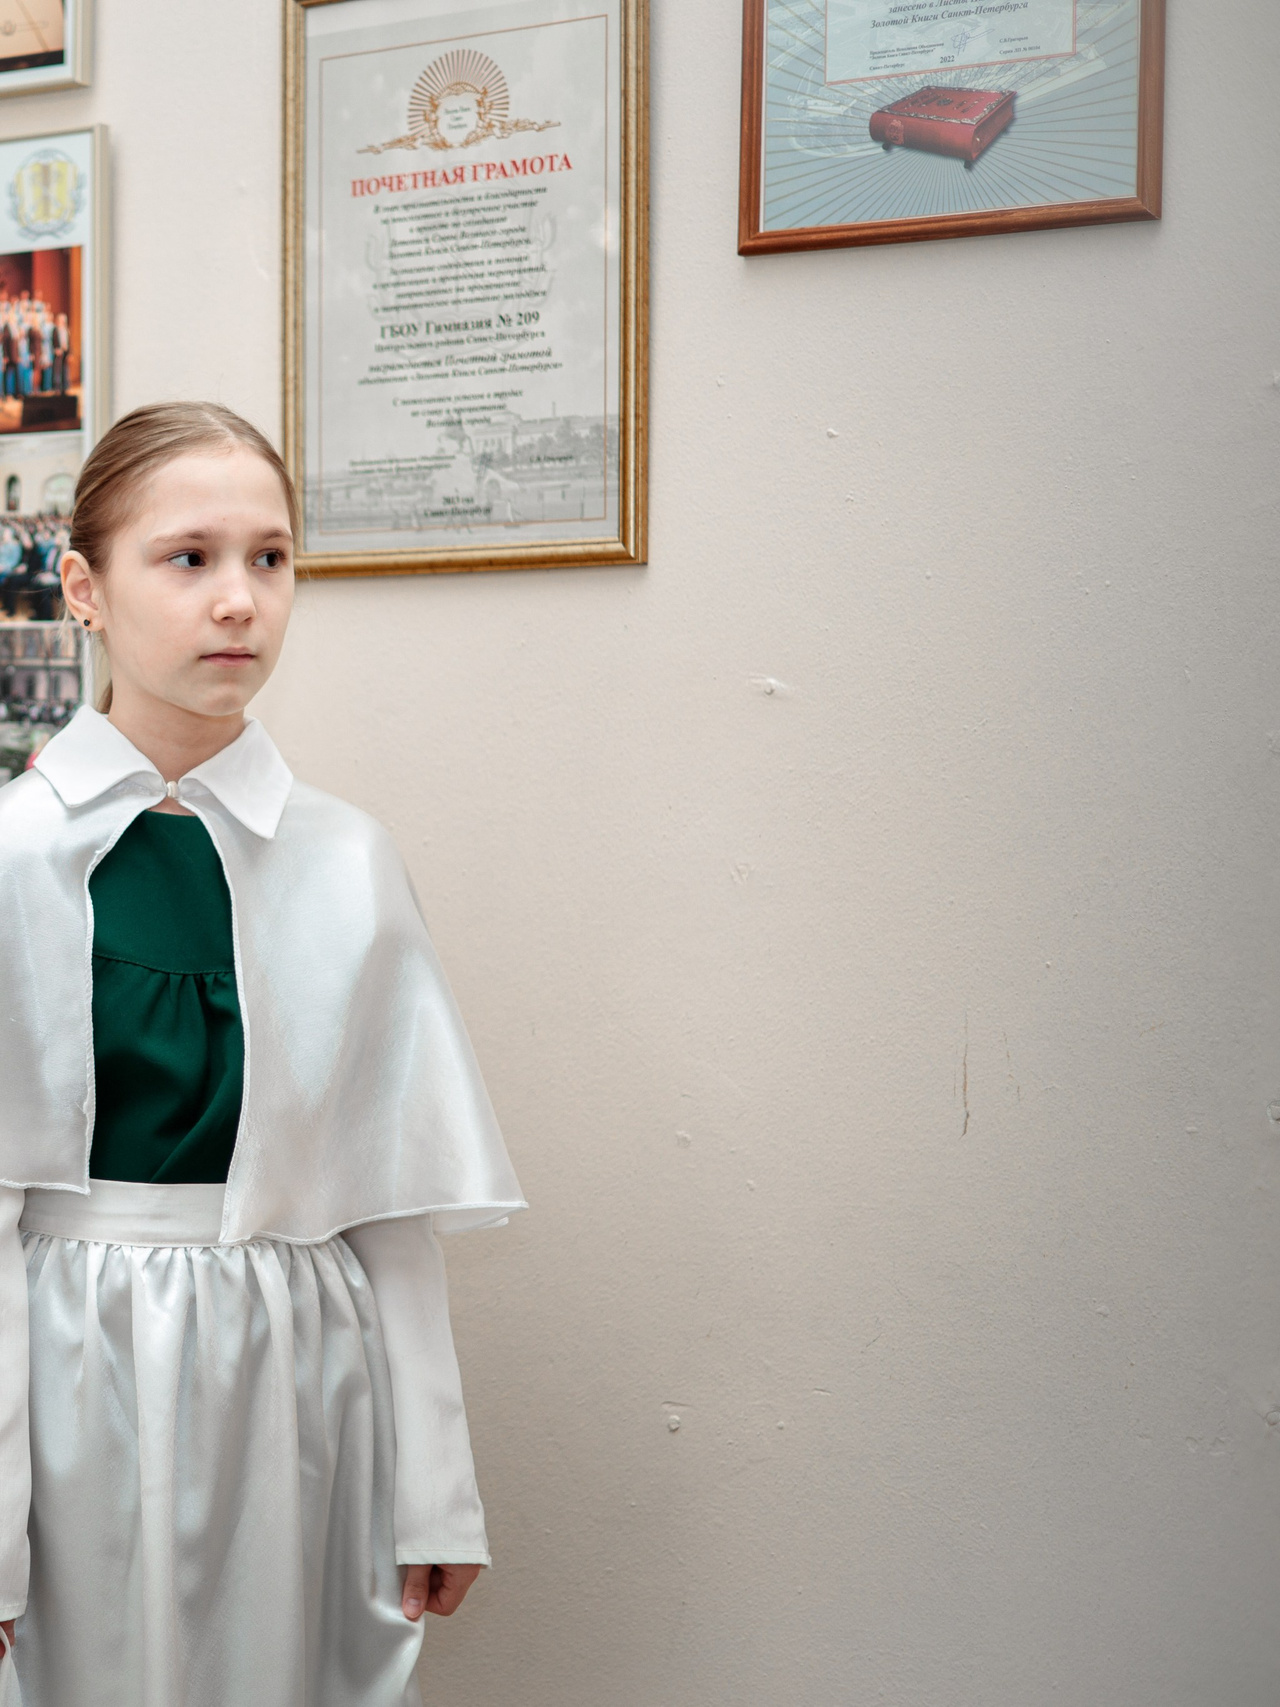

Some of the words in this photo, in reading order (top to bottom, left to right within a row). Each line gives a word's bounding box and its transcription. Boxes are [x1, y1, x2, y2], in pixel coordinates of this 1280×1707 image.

[871, 14, 909, 28] Золотой
[911, 12, 939, 24] Книги
[941, 1, 1029, 20] Санкт-Петербурга
[888, 2, 926, 14] занесено
[940, 55, 955, 63] 2022
[350, 164, 466, 198] ПОЧЕТНАЯ
[471, 153, 573, 183] ГРАМОТА
[380, 322, 419, 340] ГБОУ
[425, 316, 493, 336] Гимназия
[496, 313, 513, 328] №
[516, 310, 541, 326] 209
